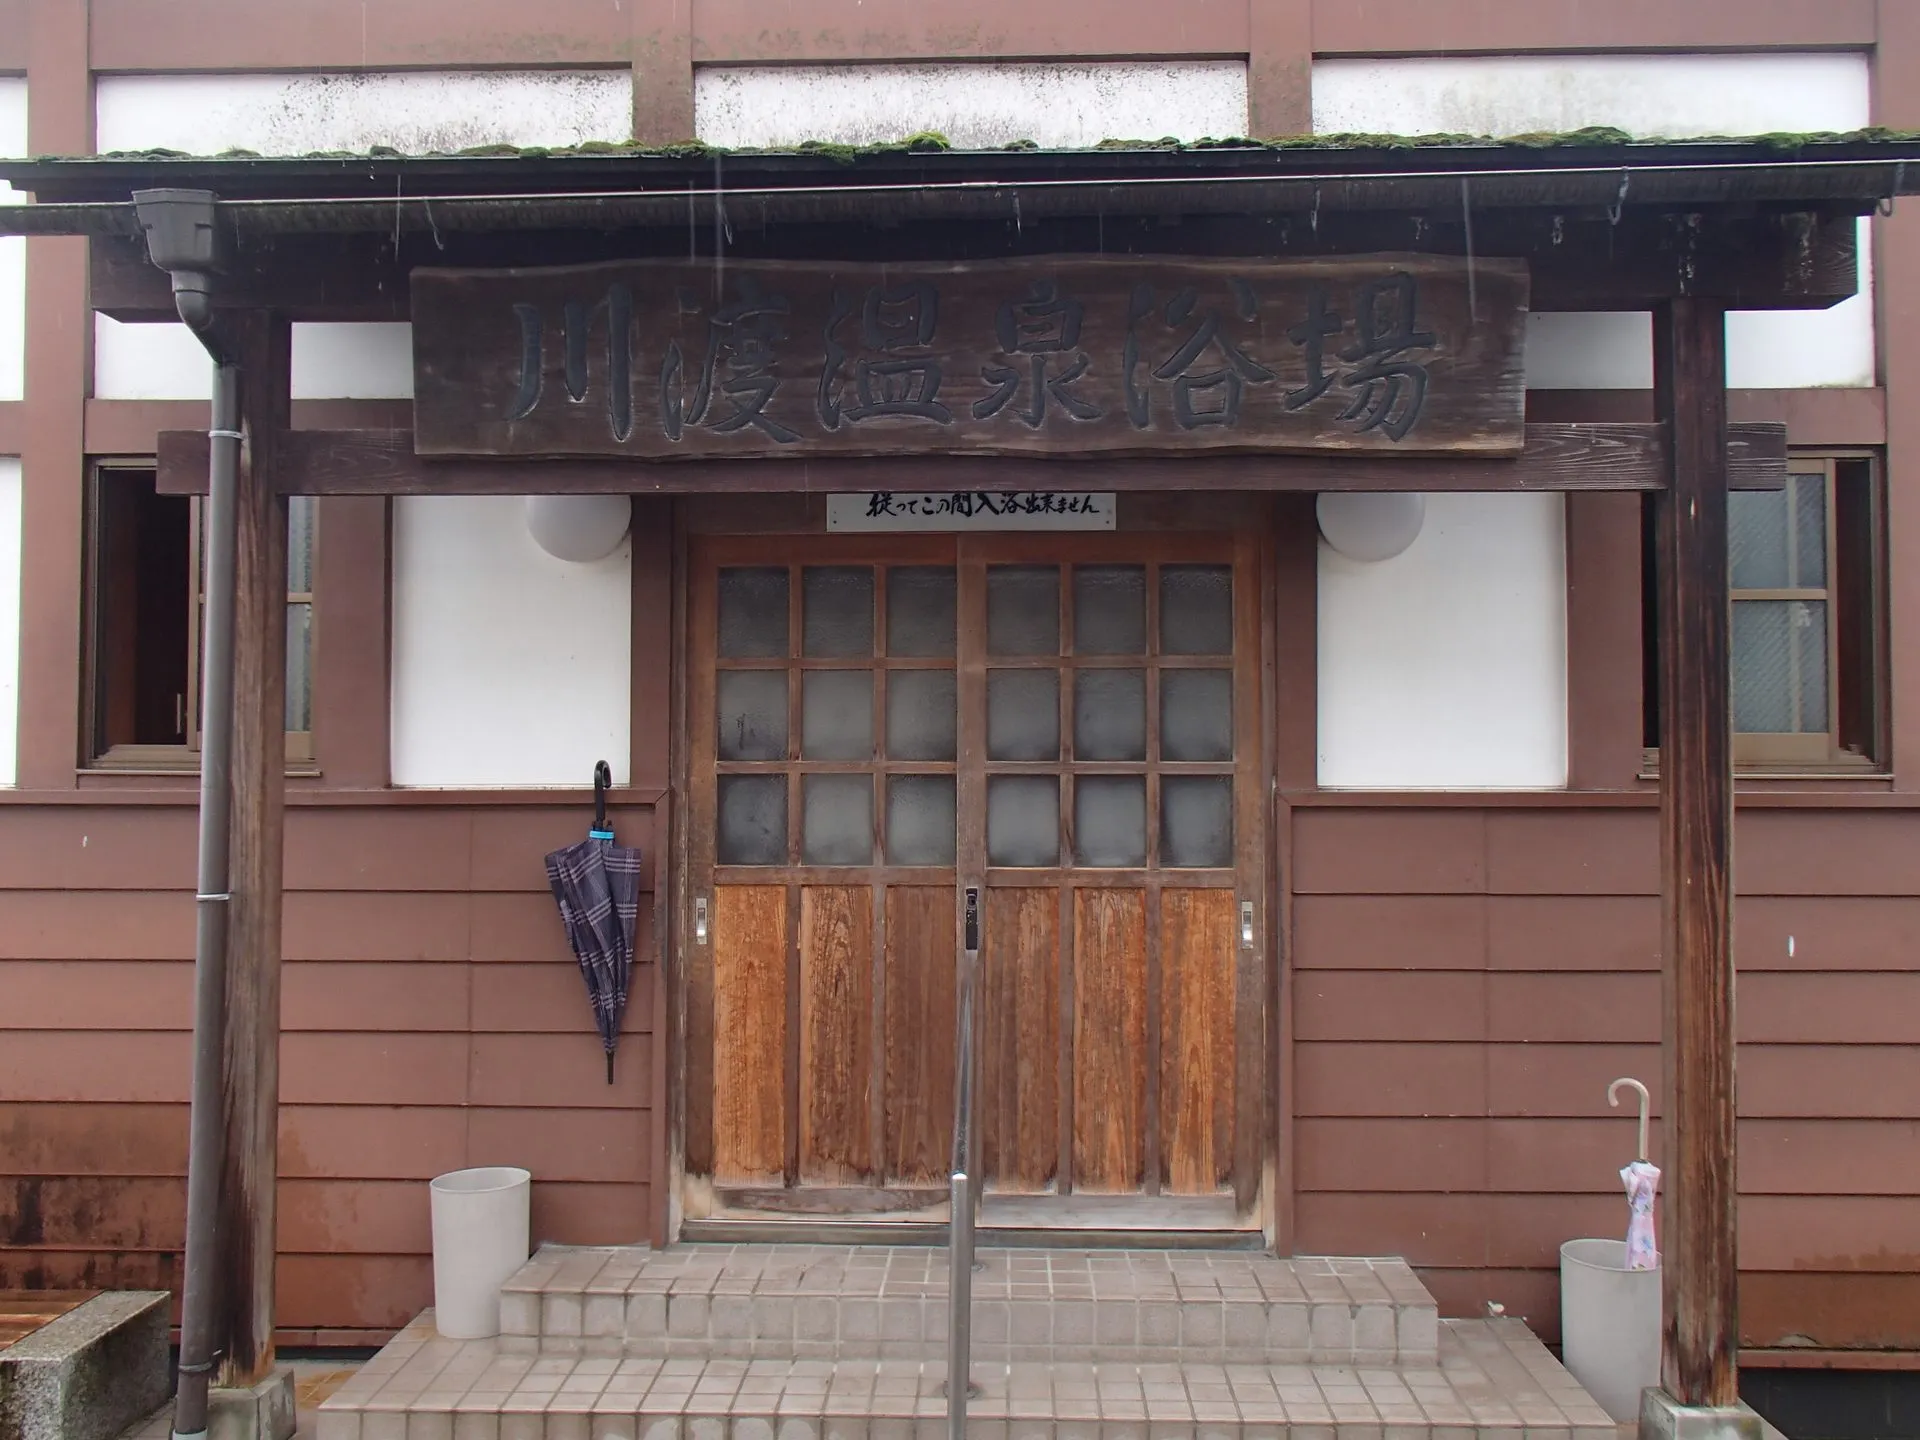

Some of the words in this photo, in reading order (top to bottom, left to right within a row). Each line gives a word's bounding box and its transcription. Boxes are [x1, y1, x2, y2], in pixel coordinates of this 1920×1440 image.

[507, 273, 1436, 443] 川渡温泉浴場
